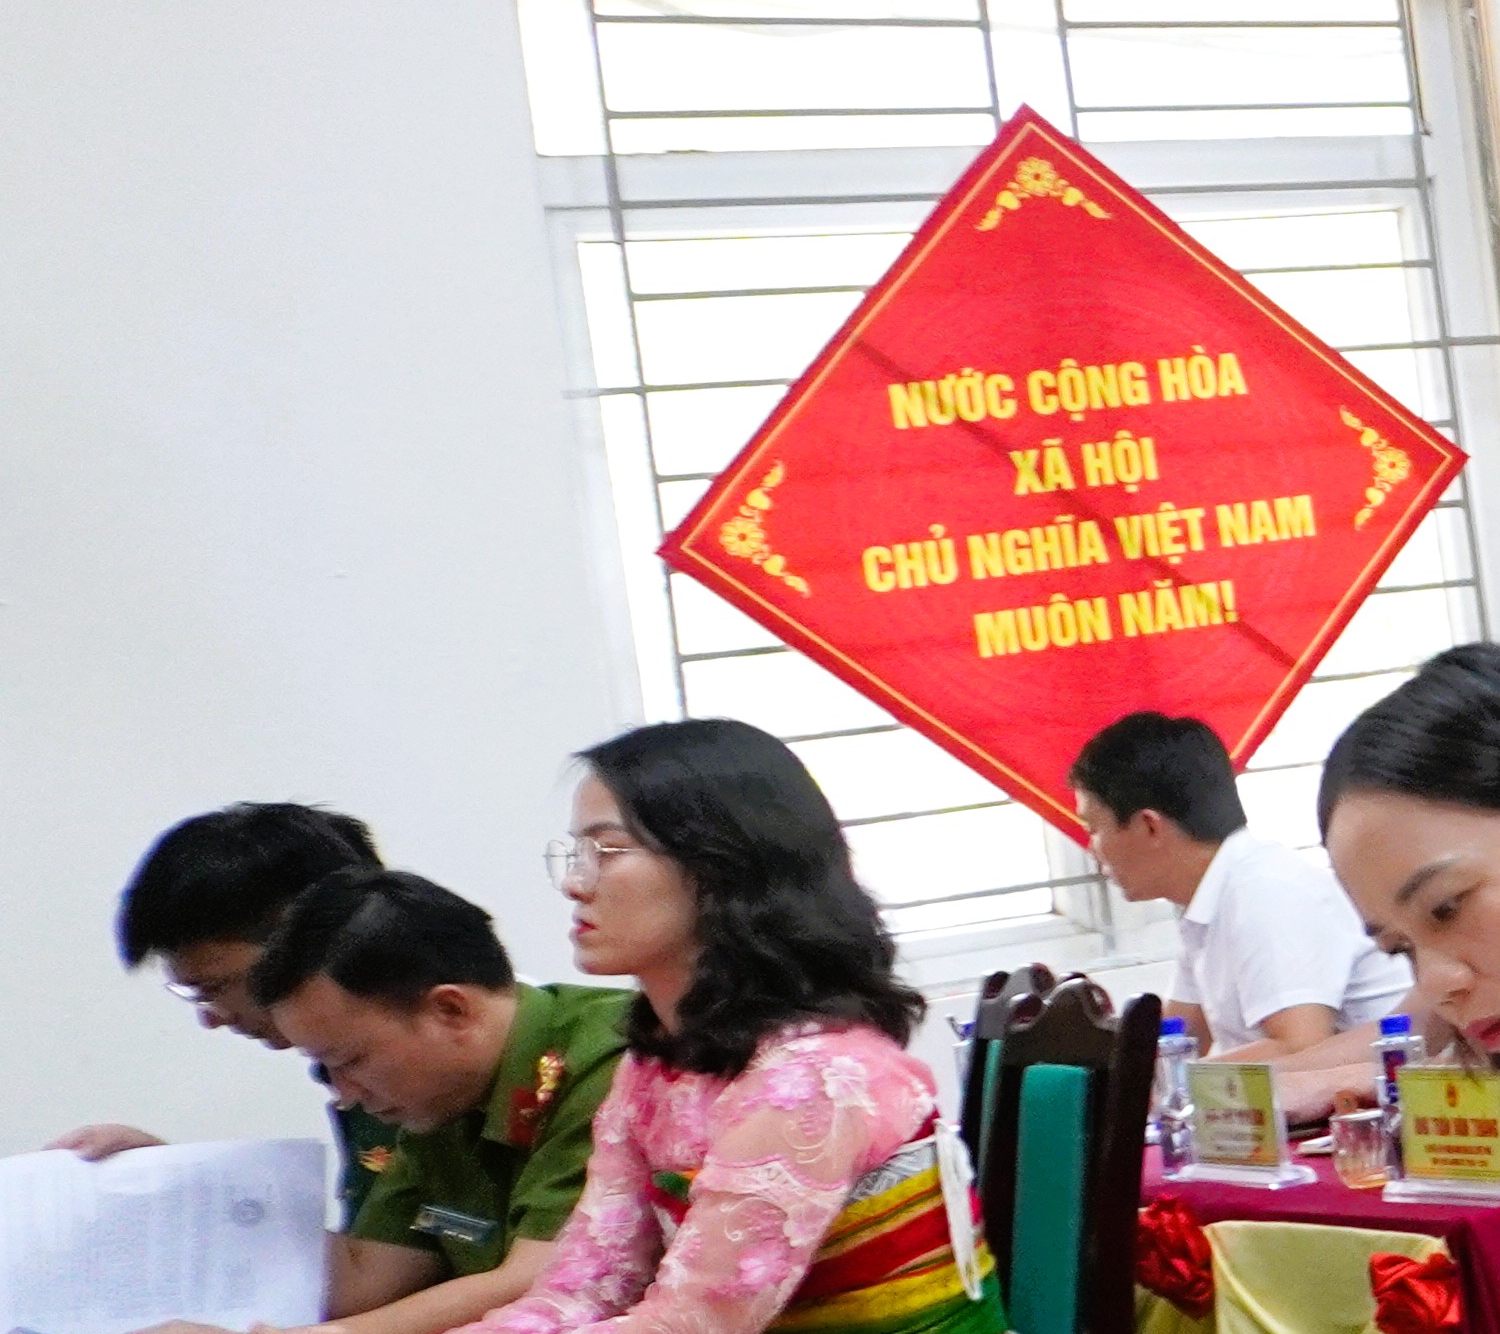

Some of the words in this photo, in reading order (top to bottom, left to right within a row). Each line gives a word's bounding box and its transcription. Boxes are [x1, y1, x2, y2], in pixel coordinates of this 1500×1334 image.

[888, 367, 1018, 431] NƯỚC
[1026, 358, 1152, 423] CỘNG
[1157, 344, 1248, 402] HÒA
[1010, 439, 1076, 497] XÃ
[1080, 430, 1158, 494] HỘI
[862, 523, 958, 593] CHỦ
[966, 511, 1110, 581] NGHĨA
[1113, 503, 1206, 565] VIỆT
[1215, 494, 1317, 549] NAM
[973, 590, 1112, 659] MUÔN
[1118, 577, 1238, 638] NĂM!
